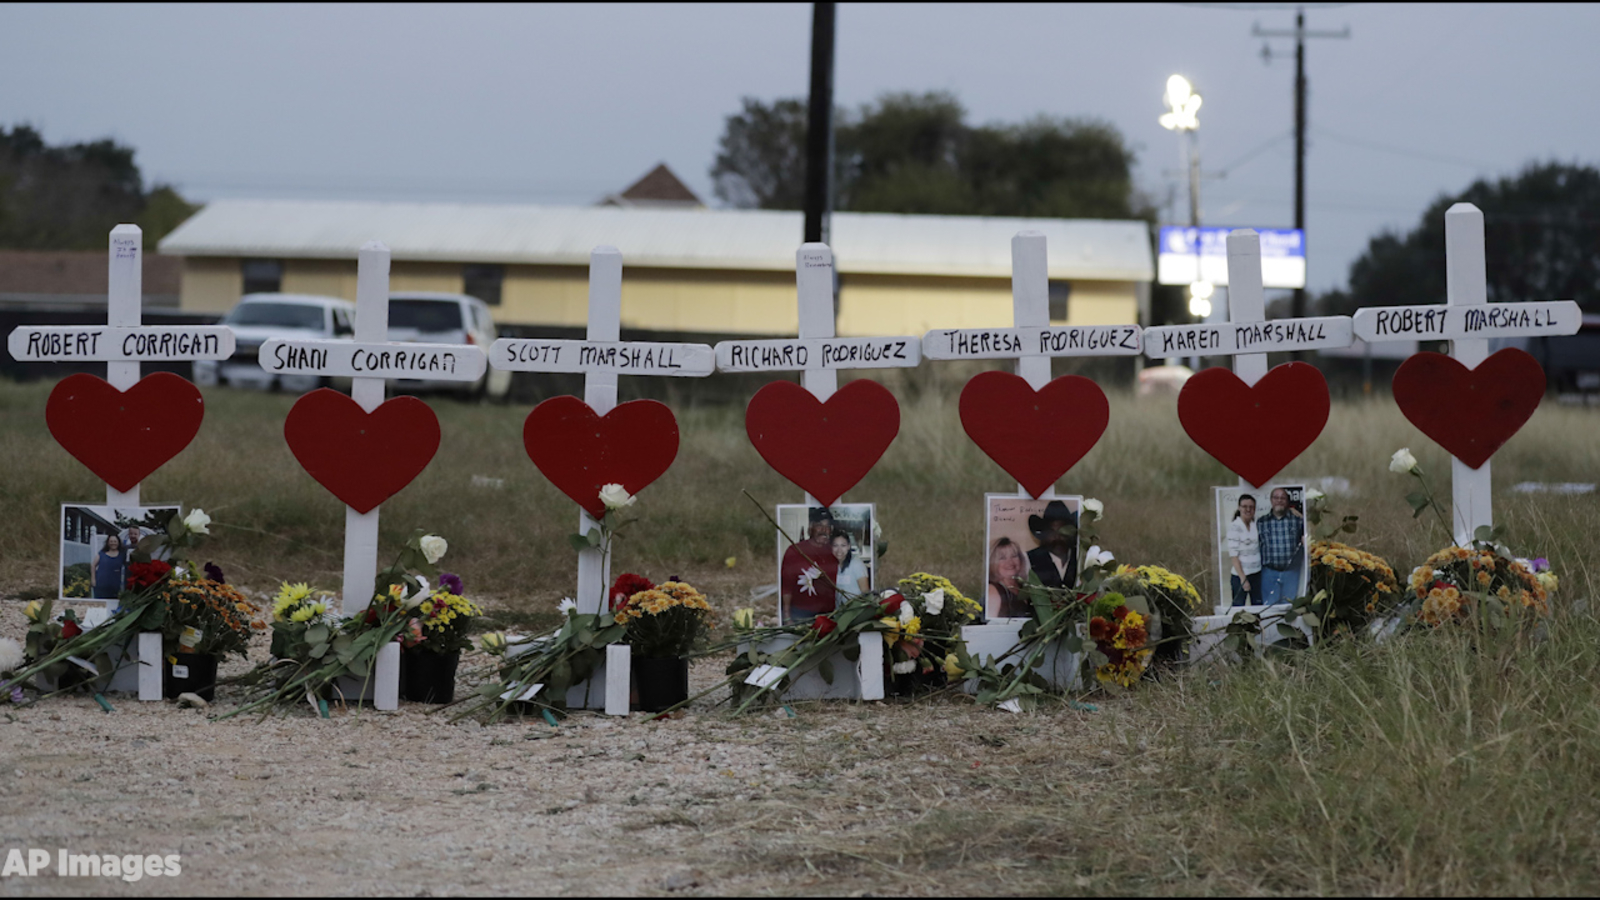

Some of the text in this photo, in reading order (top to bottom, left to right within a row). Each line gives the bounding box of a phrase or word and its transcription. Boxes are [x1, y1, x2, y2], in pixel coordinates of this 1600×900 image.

[1376, 307, 1558, 335] ROBERT MARSHALL
[27, 331, 220, 359] ROBERT CORRIGAN
[943, 328, 1138, 354] THERESA RODRIGUEZ
[1162, 322, 1327, 352] KAREN MARSHALL
[273, 344, 456, 374] SHANI CORRIGAN
[507, 343, 682, 368] SCOTT MARSHALL
[731, 341, 907, 368] RICHARD RODRIGUEZ
